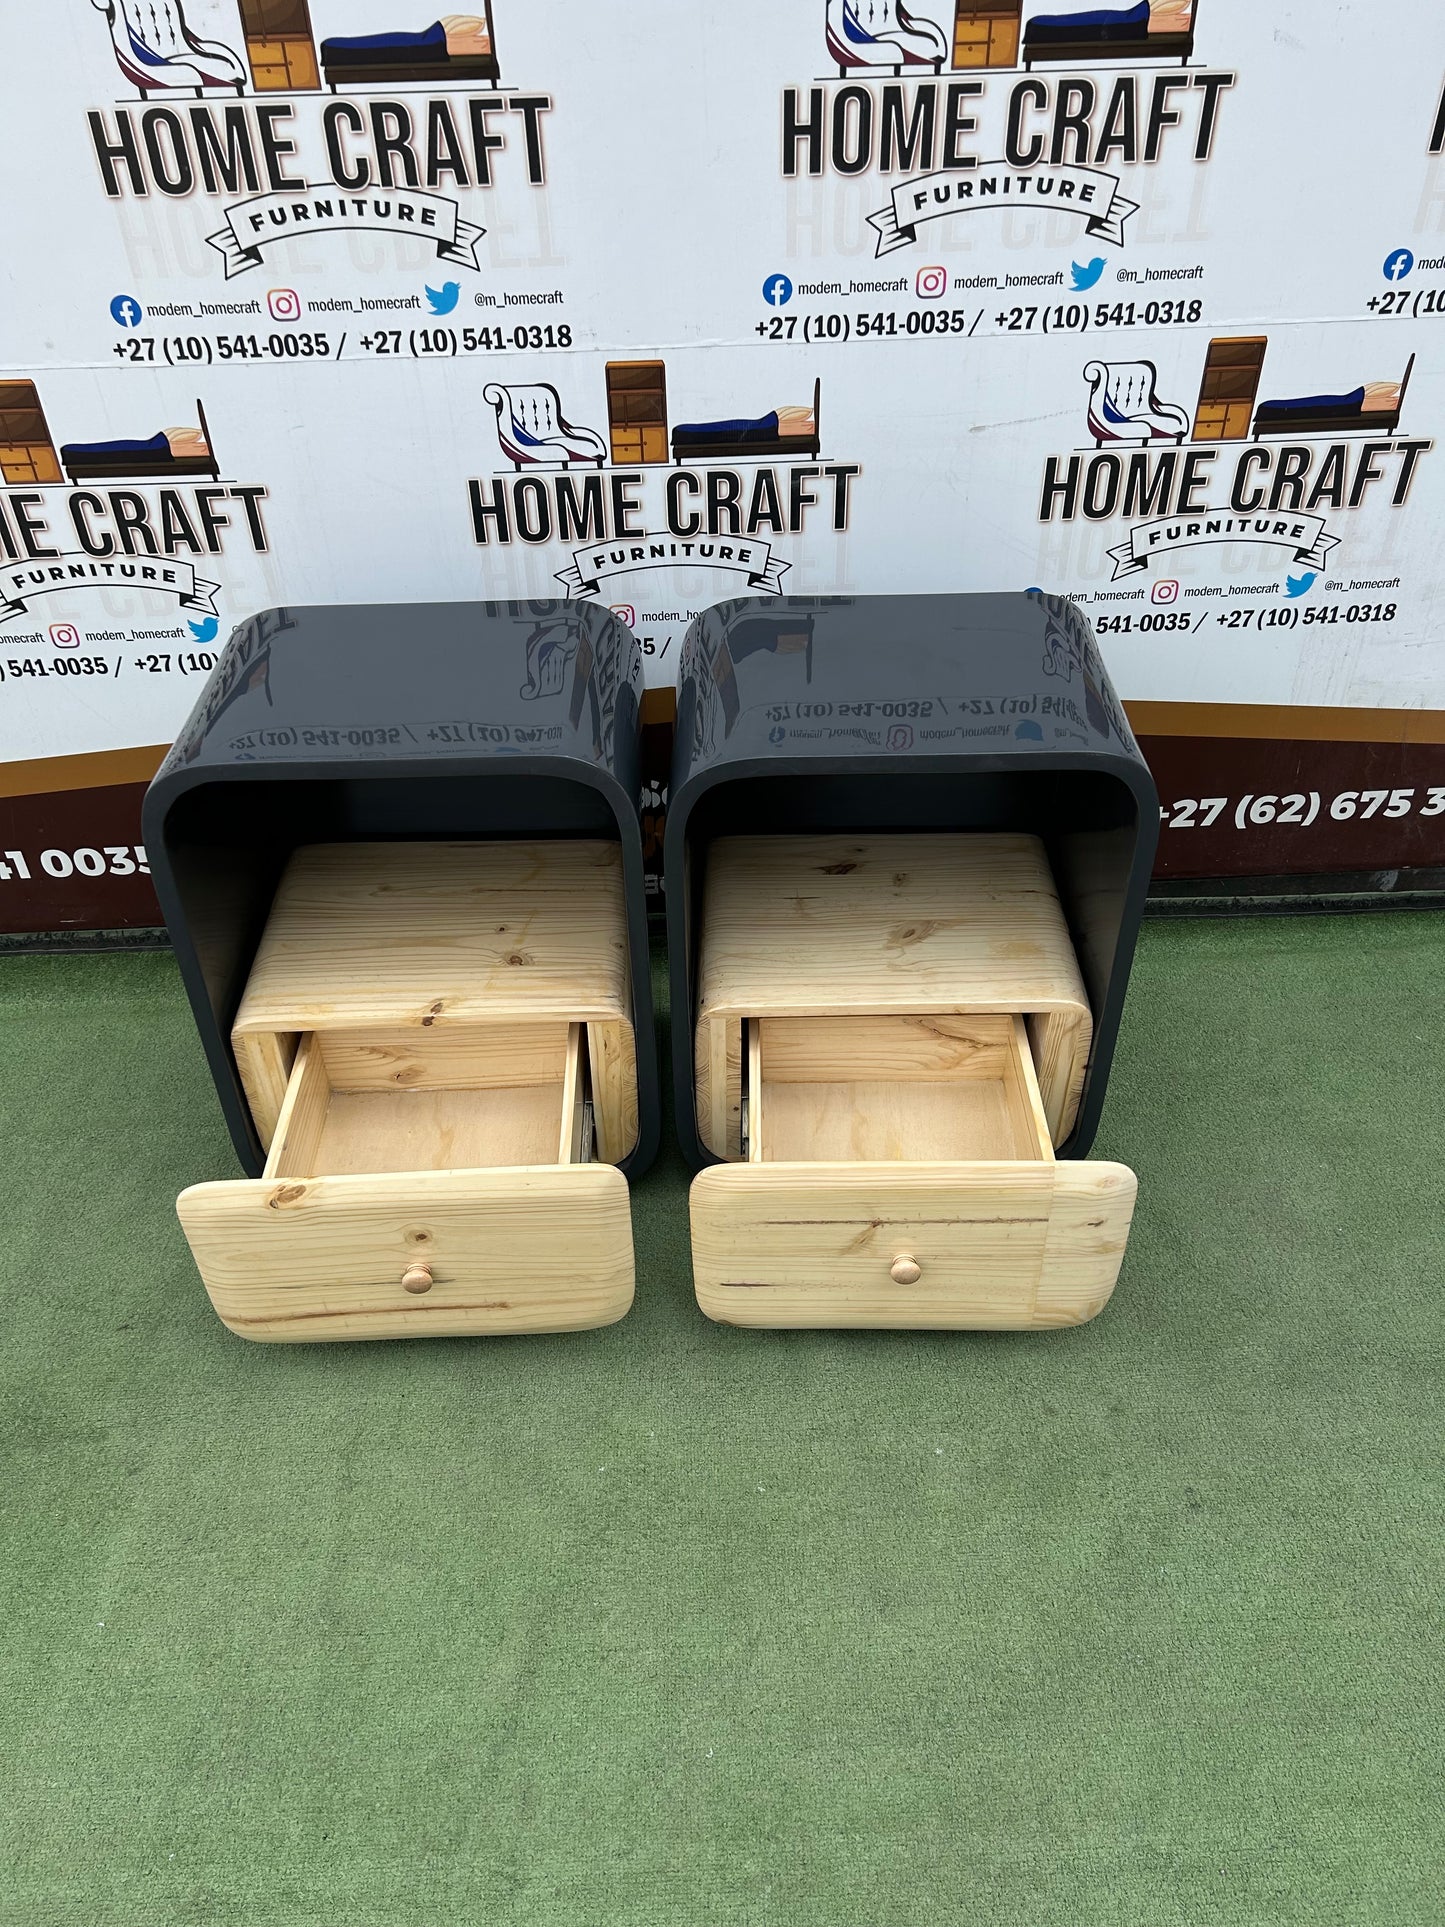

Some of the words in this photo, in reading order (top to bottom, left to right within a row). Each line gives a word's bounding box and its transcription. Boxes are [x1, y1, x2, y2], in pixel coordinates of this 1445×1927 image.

[783, 82, 983, 175] HOME
[1005, 73, 1234, 168] CRAFT
[87, 105, 306, 196] HOME
[322, 97, 549, 190] CRAFT
[913, 177, 1096, 210] FURNITURE
[249, 199, 437, 233] FURNITURE
[1116, 265, 1204, 284] @m_homecraft
[474, 290, 564, 308] @m_homecraft
[1366, 290, 1411, 314] +27
[755, 316, 798, 340] +27
[803, 314, 850, 343] (10)
[855, 309, 964, 337] 541-0035
[995, 307, 1038, 331] +27
[1042, 304, 1089, 334] (10)
[1094, 300, 1203, 328] 541-0318
[113, 337, 155, 362] +27
[163, 336, 213, 366] (10)
[217, 332, 330, 360] 541-0035
[360, 330, 402, 354] +27
[410, 328, 458, 357] (10)
[462, 324, 573, 351] 541-0318
[1039, 450, 1217, 521] HOME
[1231, 440, 1431, 513] CRAFT
[467, 473, 645, 543] HOME
[667, 465, 860, 537] CRAFT
[69, 487, 267, 558] CRAFT
[1149, 519, 1306, 546] FURNITURE
[593, 543, 752, 570] FURNITURE
[11, 563, 177, 589] FURNITURE
[1325, 577, 1400, 593] @m_homecraft
[1095, 612, 1191, 635] 541-0035
[1217, 610, 1255, 628] +27
[1257, 608, 1299, 631] (10)
[1302, 603, 1397, 625] 541-0318
[7, 656, 109, 678] 541-0035
[134, 654, 171, 674] +27
[1235, 791, 1320, 829] (62)
[1330, 789, 1414, 820] 675
